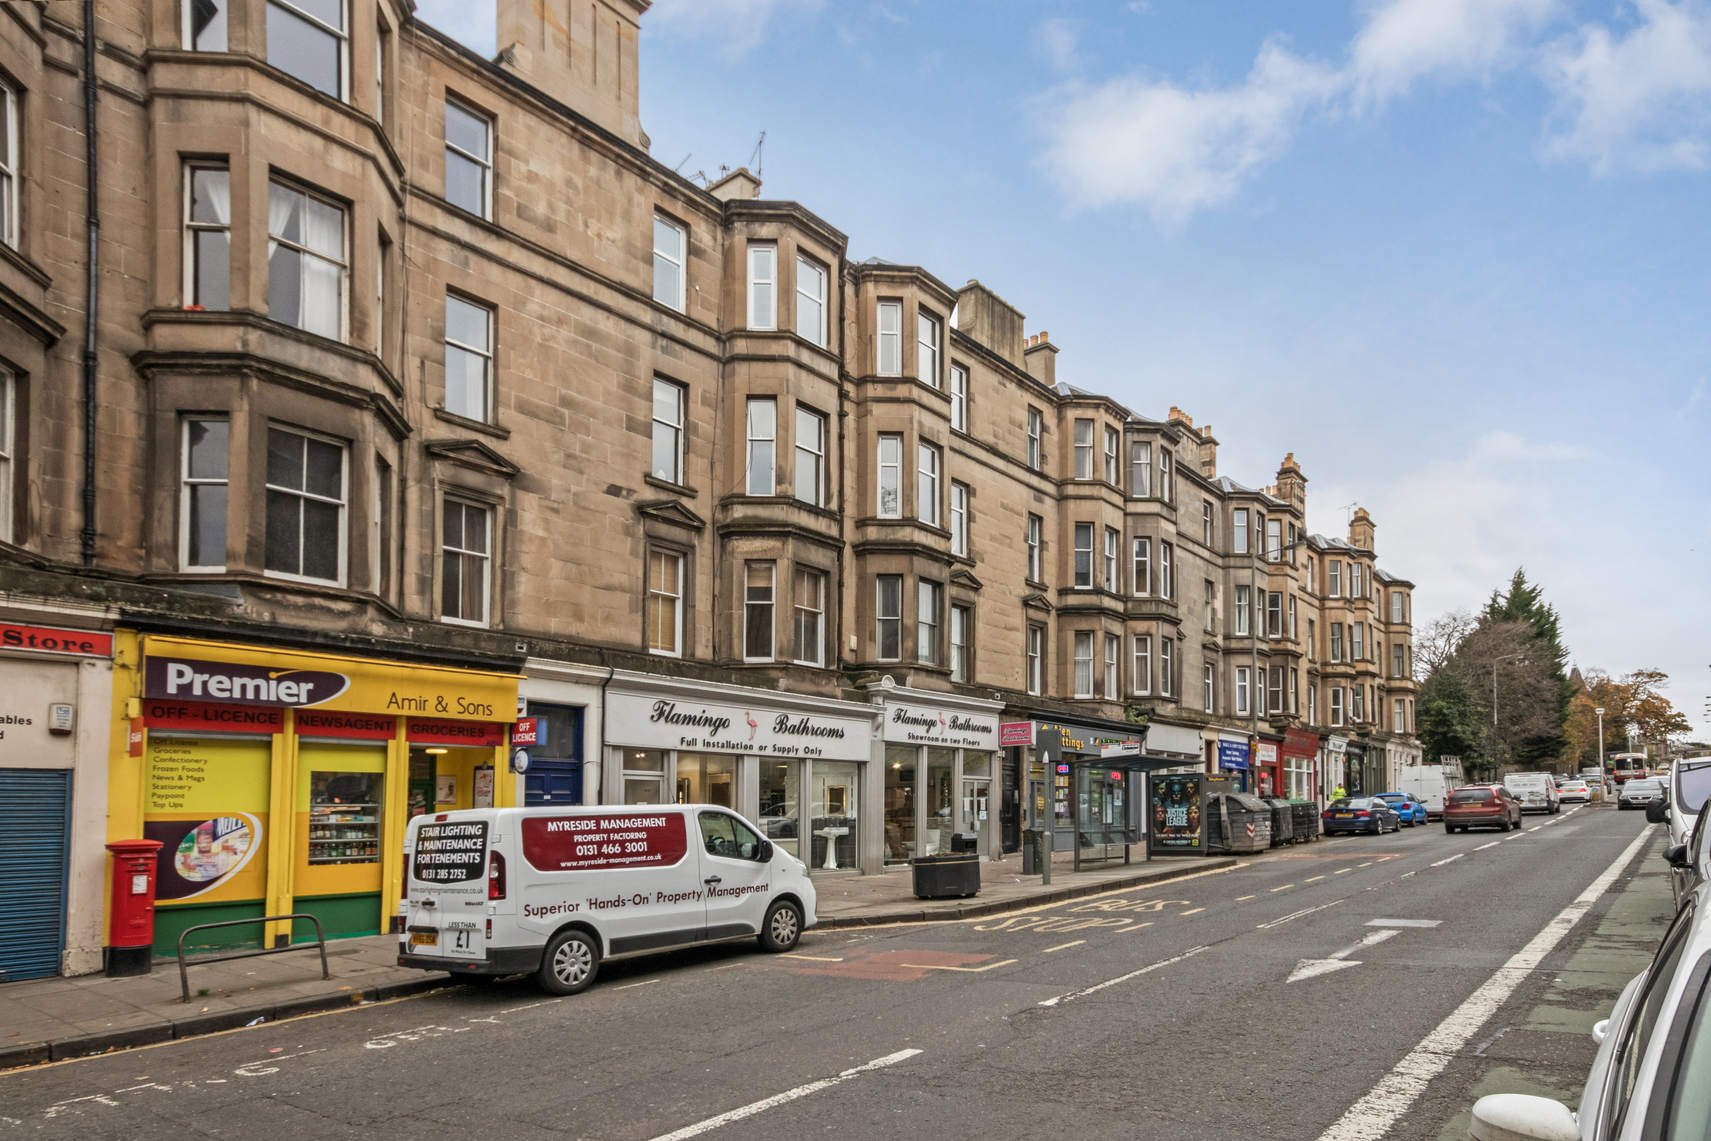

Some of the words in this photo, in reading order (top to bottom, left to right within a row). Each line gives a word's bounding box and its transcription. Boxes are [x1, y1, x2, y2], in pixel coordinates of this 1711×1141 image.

[3, 629, 94, 653] Store
[166, 662, 314, 703] Premier
[387, 691, 429, 712] Amir
[435, 695, 449, 713] &
[457, 696, 493, 717] Sons
[151, 706, 188, 720] OFF
[204, 709, 279, 724] LICENCE
[650, 700, 731, 737] Flamingo
[772, 712, 845, 739] Bathrooms
[892, 708, 937, 733] Flamingo
[948, 715, 992, 734] Bathrooms
[299, 715, 392, 732] NEWSAGENT
[411, 723, 485, 738] GROCERIES
[519, 722, 530, 731] OFF
[512, 732, 536, 742] LICENCE
[907, 732, 939, 743] Showroom
[962, 738, 980, 747] Floors
[680, 736, 697, 747] Full
[702, 738, 754, 751] Installation
[758, 744, 768, 752] or
[772, 743, 800, 755] Supply
[803, 745, 823, 756] Only
[153, 756, 207, 765] Confectionery
[182, 765, 204, 773] Foods
[186, 775, 205, 783] Mags
[152, 783, 192, 791] Stationery
[152, 792, 185, 800] Paypoint
[547, 820, 597, 832] MYRESIDE
[600, 817, 666, 830] MANAGEMENT
[1166, 815, 1188, 826] LEAGUE
[420, 827, 440, 837] STAIR
[441, 825, 482, 836] LIGHTING
[573, 834, 608, 842] PROPERTY
[610, 831, 647, 841] FACTORING
[418, 841, 423, 850] &
[424, 839, 483, 850] MAINTENANCE
[576, 845, 598, 856] 0131
[601, 844, 621, 854] 466
[624, 842, 648, 853] 3001
[417, 854, 430, 864] FOR
[431, 853, 480, 863] TENEMENTS
[560, 853, 662, 867] www.myreside-management.co.uk
[422, 869, 435, 879] 0131
[437, 869, 448, 879] 285
[449, 869, 466, 879] 2752
[524, 901, 580, 918] Superior
[586, 893, 652, 910] 'Hands-On'
[656, 890, 703, 904] Property
[707, 883, 769, 898] Management
[1066, 899, 1191, 912] BUS
[974, 916, 1133, 933] STOP
[456, 930, 469, 948] £1
